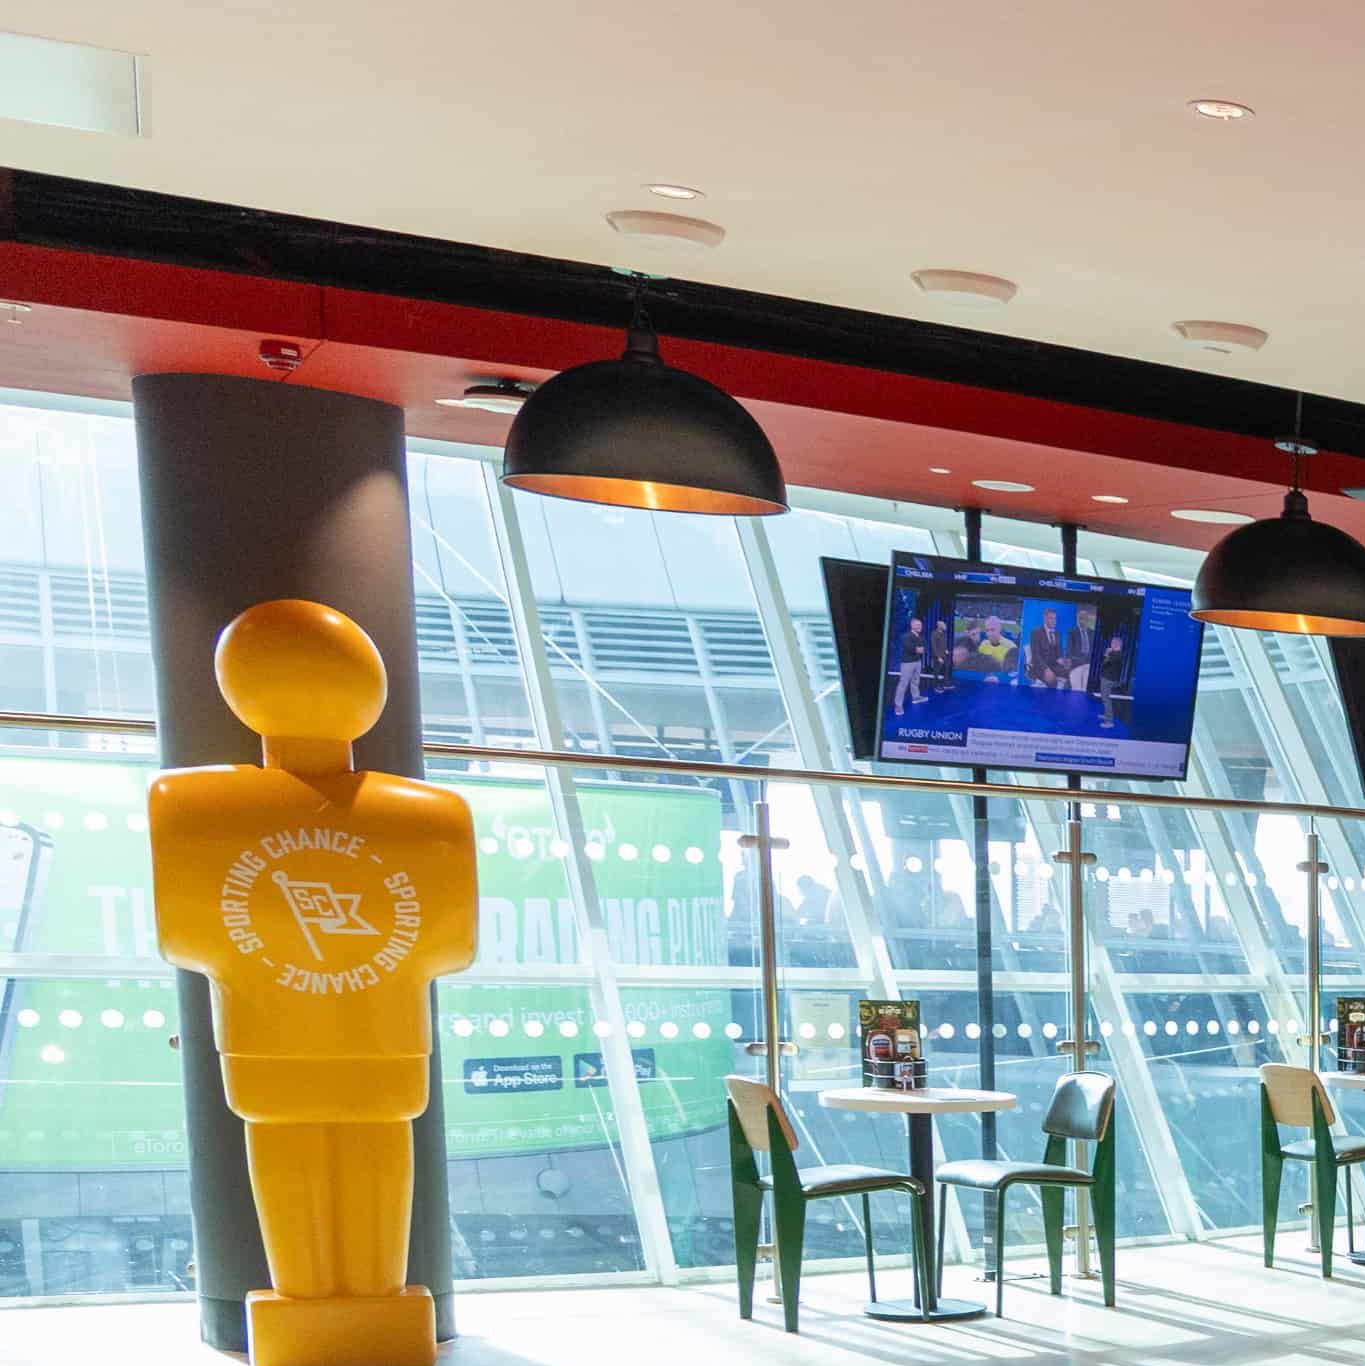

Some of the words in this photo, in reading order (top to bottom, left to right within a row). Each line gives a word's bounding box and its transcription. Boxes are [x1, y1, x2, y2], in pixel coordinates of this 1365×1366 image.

[898, 727, 929, 739] RUGBY
[931, 730, 963, 741] UNION
[220, 850, 267, 955] SPORTING
[260, 827, 366, 859] CHANCE
[372, 871, 421, 972] SPORTING
[275, 963, 380, 995] CHANCE
